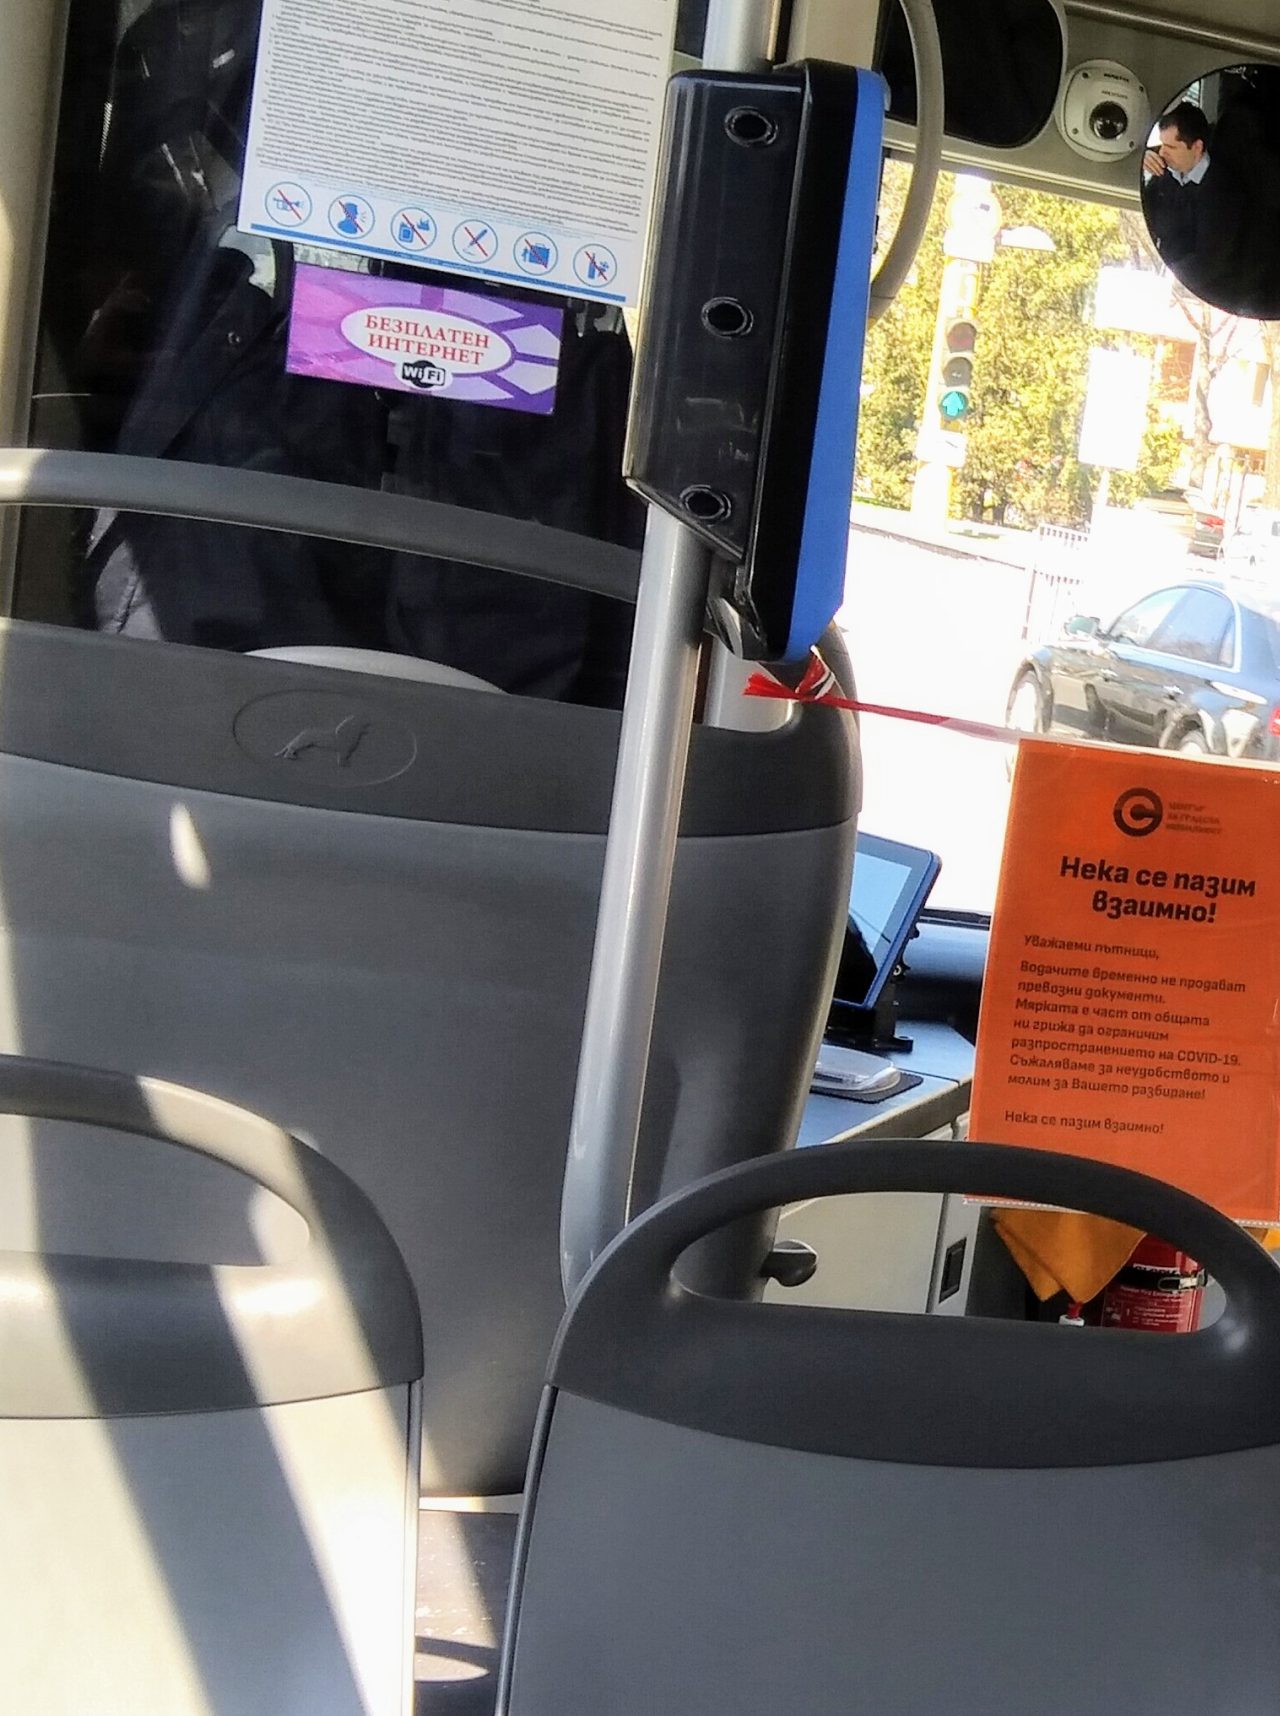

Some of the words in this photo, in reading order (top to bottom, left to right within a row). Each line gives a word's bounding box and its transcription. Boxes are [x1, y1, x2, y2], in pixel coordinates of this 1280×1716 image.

[366, 314, 490, 348] БЕЗПЛАТЕН
[368, 333, 485, 365] ИНТЕРНЕТ
[1060, 856, 1129, 883] Нека
[1135, 868, 1168, 887] се
[1173, 872, 1256, 898] пазим
[1092, 890, 1216, 923] взаимно!
[1024, 935, 1092, 952] Уважаеми
[1094, 944, 1160, 960] пътници,
[1020, 960, 1090, 978] Водачите
[1092, 967, 1158, 984] временно
[1160, 975, 1179, 987] не
[1179, 978, 1246, 992] продават
[1018, 981, 1082, 997] превозни
[1085, 987, 1165, 1004] документи.
[1015, 998, 1079, 1014] Мярката
[1081, 1006, 1090, 1016] е
[1093, 1008, 1128, 1018] част
[1130, 1011, 1154, 1022] от
[1154, 1011, 1210, 1026] общата
[1013, 1018, 1030, 1030] ни
[1033, 1021, 1075, 1033] грижа
[1078, 1024, 1094, 1037] да
[1097, 1027, 1169, 1041] ограничим
[1012, 1038, 1155, 1059] разпространението
[1158, 1050, 1175, 1061] на
[1177, 1050, 1240, 1066] COVID-19.
[1010, 1054, 1095, 1072] Съжаляваме
[1097, 1063, 1114, 1076] за
[1116, 1066, 1219, 1083] неудобството
[1221, 1073, 1231, 1085] и
[1008, 1075, 1051, 1087] молим
[1052, 1078, 1069, 1092] за
[1071, 1078, 1130, 1093] Вашето
[1132, 1085, 1205, 1099] разбиране!
[1005, 1110, 1038, 1124] Нека
[1040, 1115, 1057, 1127] се
[1060, 1117, 1101, 1130] пазим
[1104, 1118, 1164, 1134] взаимно!
